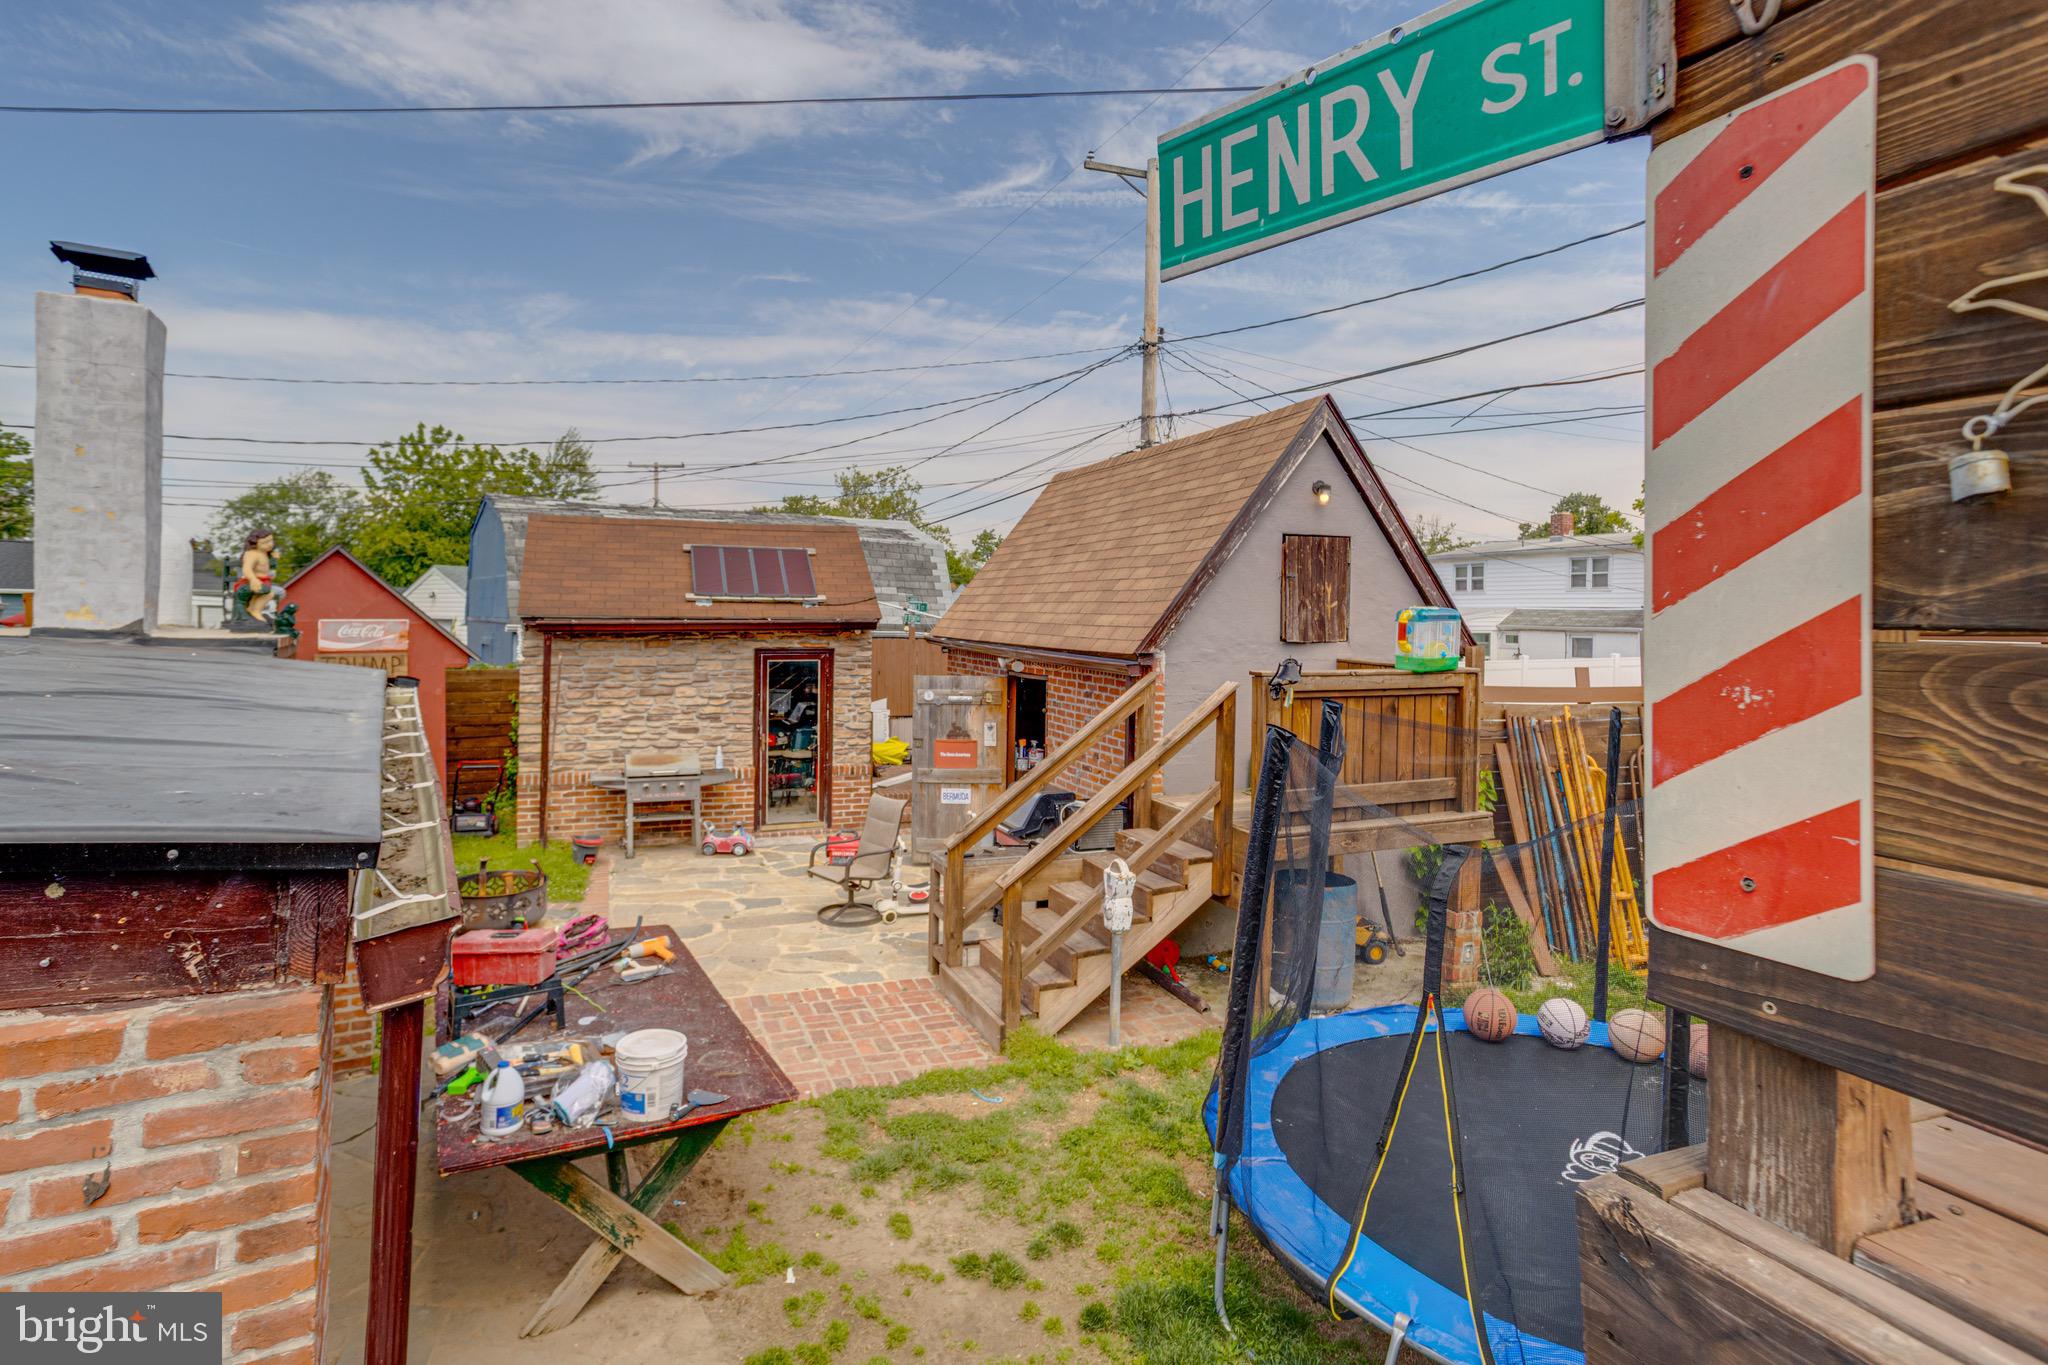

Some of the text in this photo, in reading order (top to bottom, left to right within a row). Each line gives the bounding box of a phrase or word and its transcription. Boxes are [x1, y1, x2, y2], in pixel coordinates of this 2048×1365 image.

[1173, 19, 1583, 248] HENRY ST.
[943, 792, 969, 801] BERMUDA
